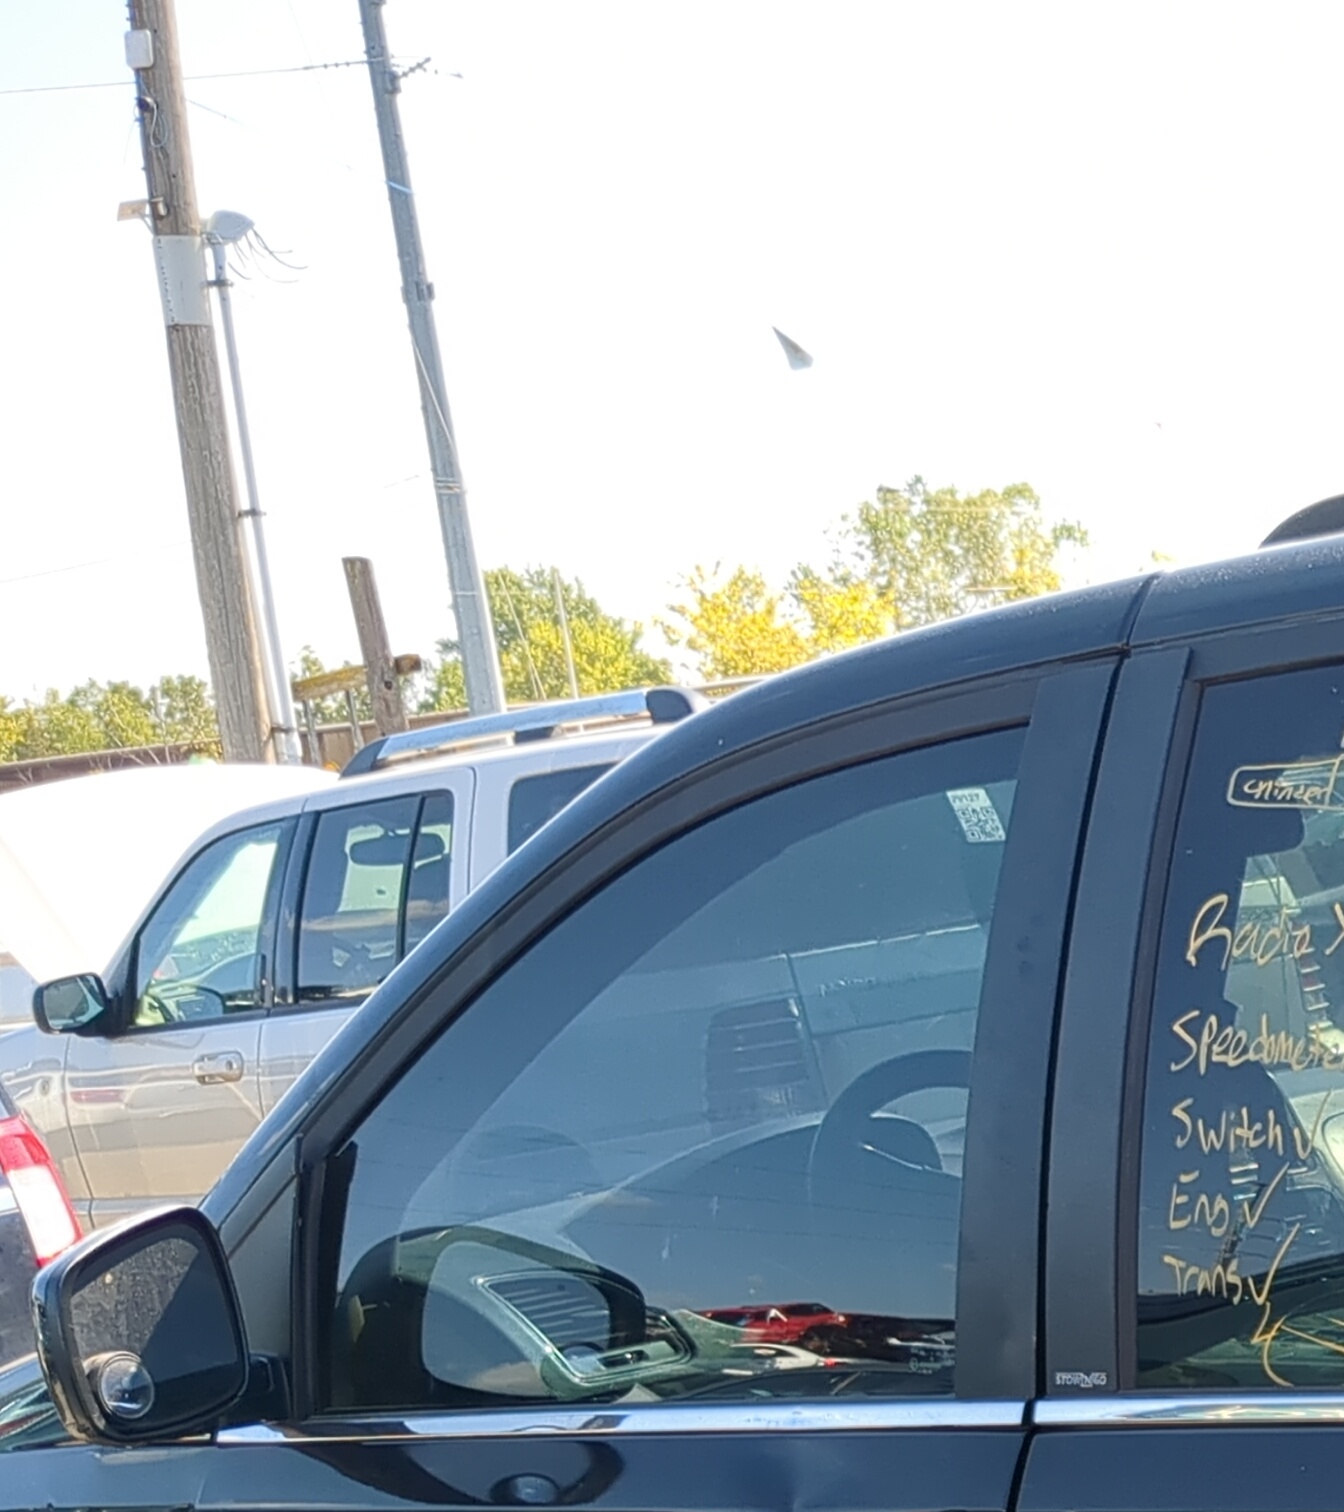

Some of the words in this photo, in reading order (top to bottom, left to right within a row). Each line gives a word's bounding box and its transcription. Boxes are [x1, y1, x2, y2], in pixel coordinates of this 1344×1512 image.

[1171, 1098, 1284, 1156] Switch
[1169, 1170, 1231, 1238] Eng
[1163, 1254, 1243, 1306] Trans
